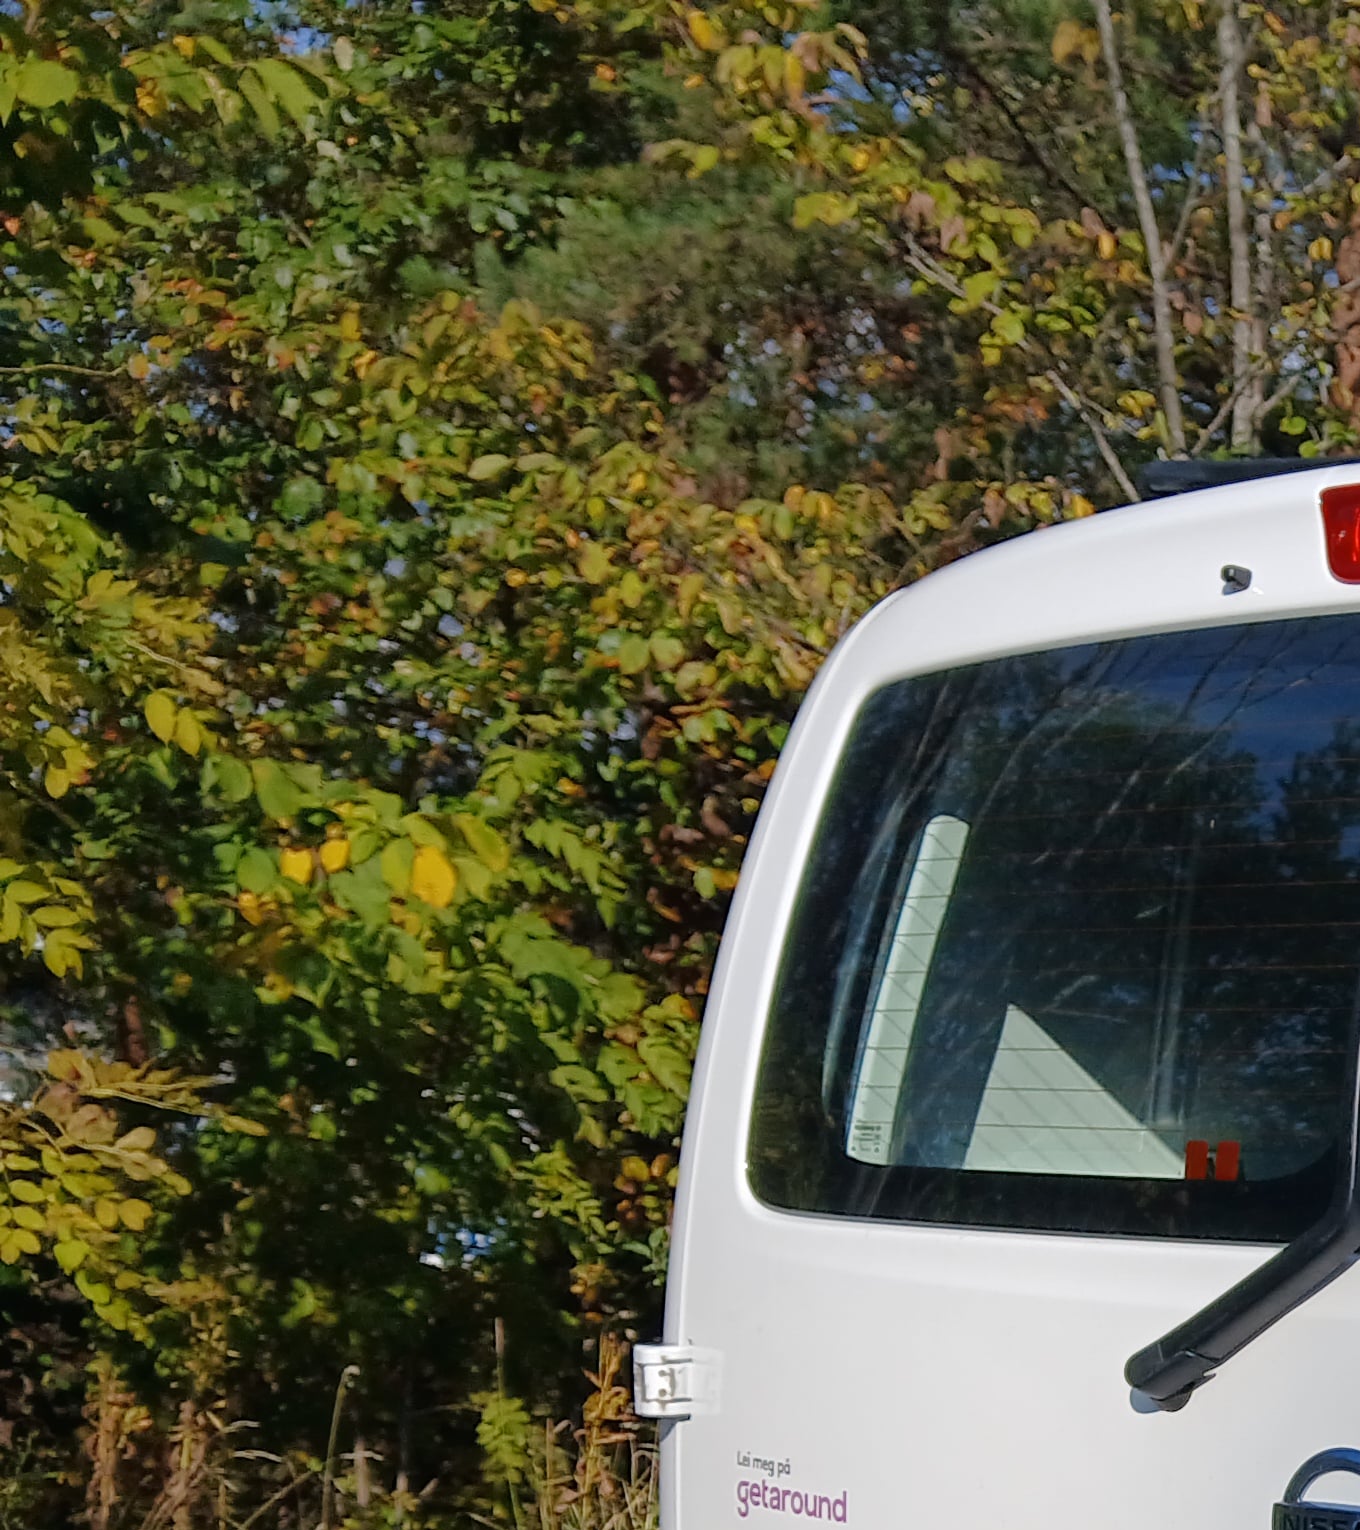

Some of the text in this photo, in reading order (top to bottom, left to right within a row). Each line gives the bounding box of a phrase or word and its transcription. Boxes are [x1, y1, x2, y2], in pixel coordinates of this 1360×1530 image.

[736, 1450, 791, 1478] Lei meg på
[736, 1479, 848, 1523] getaround
